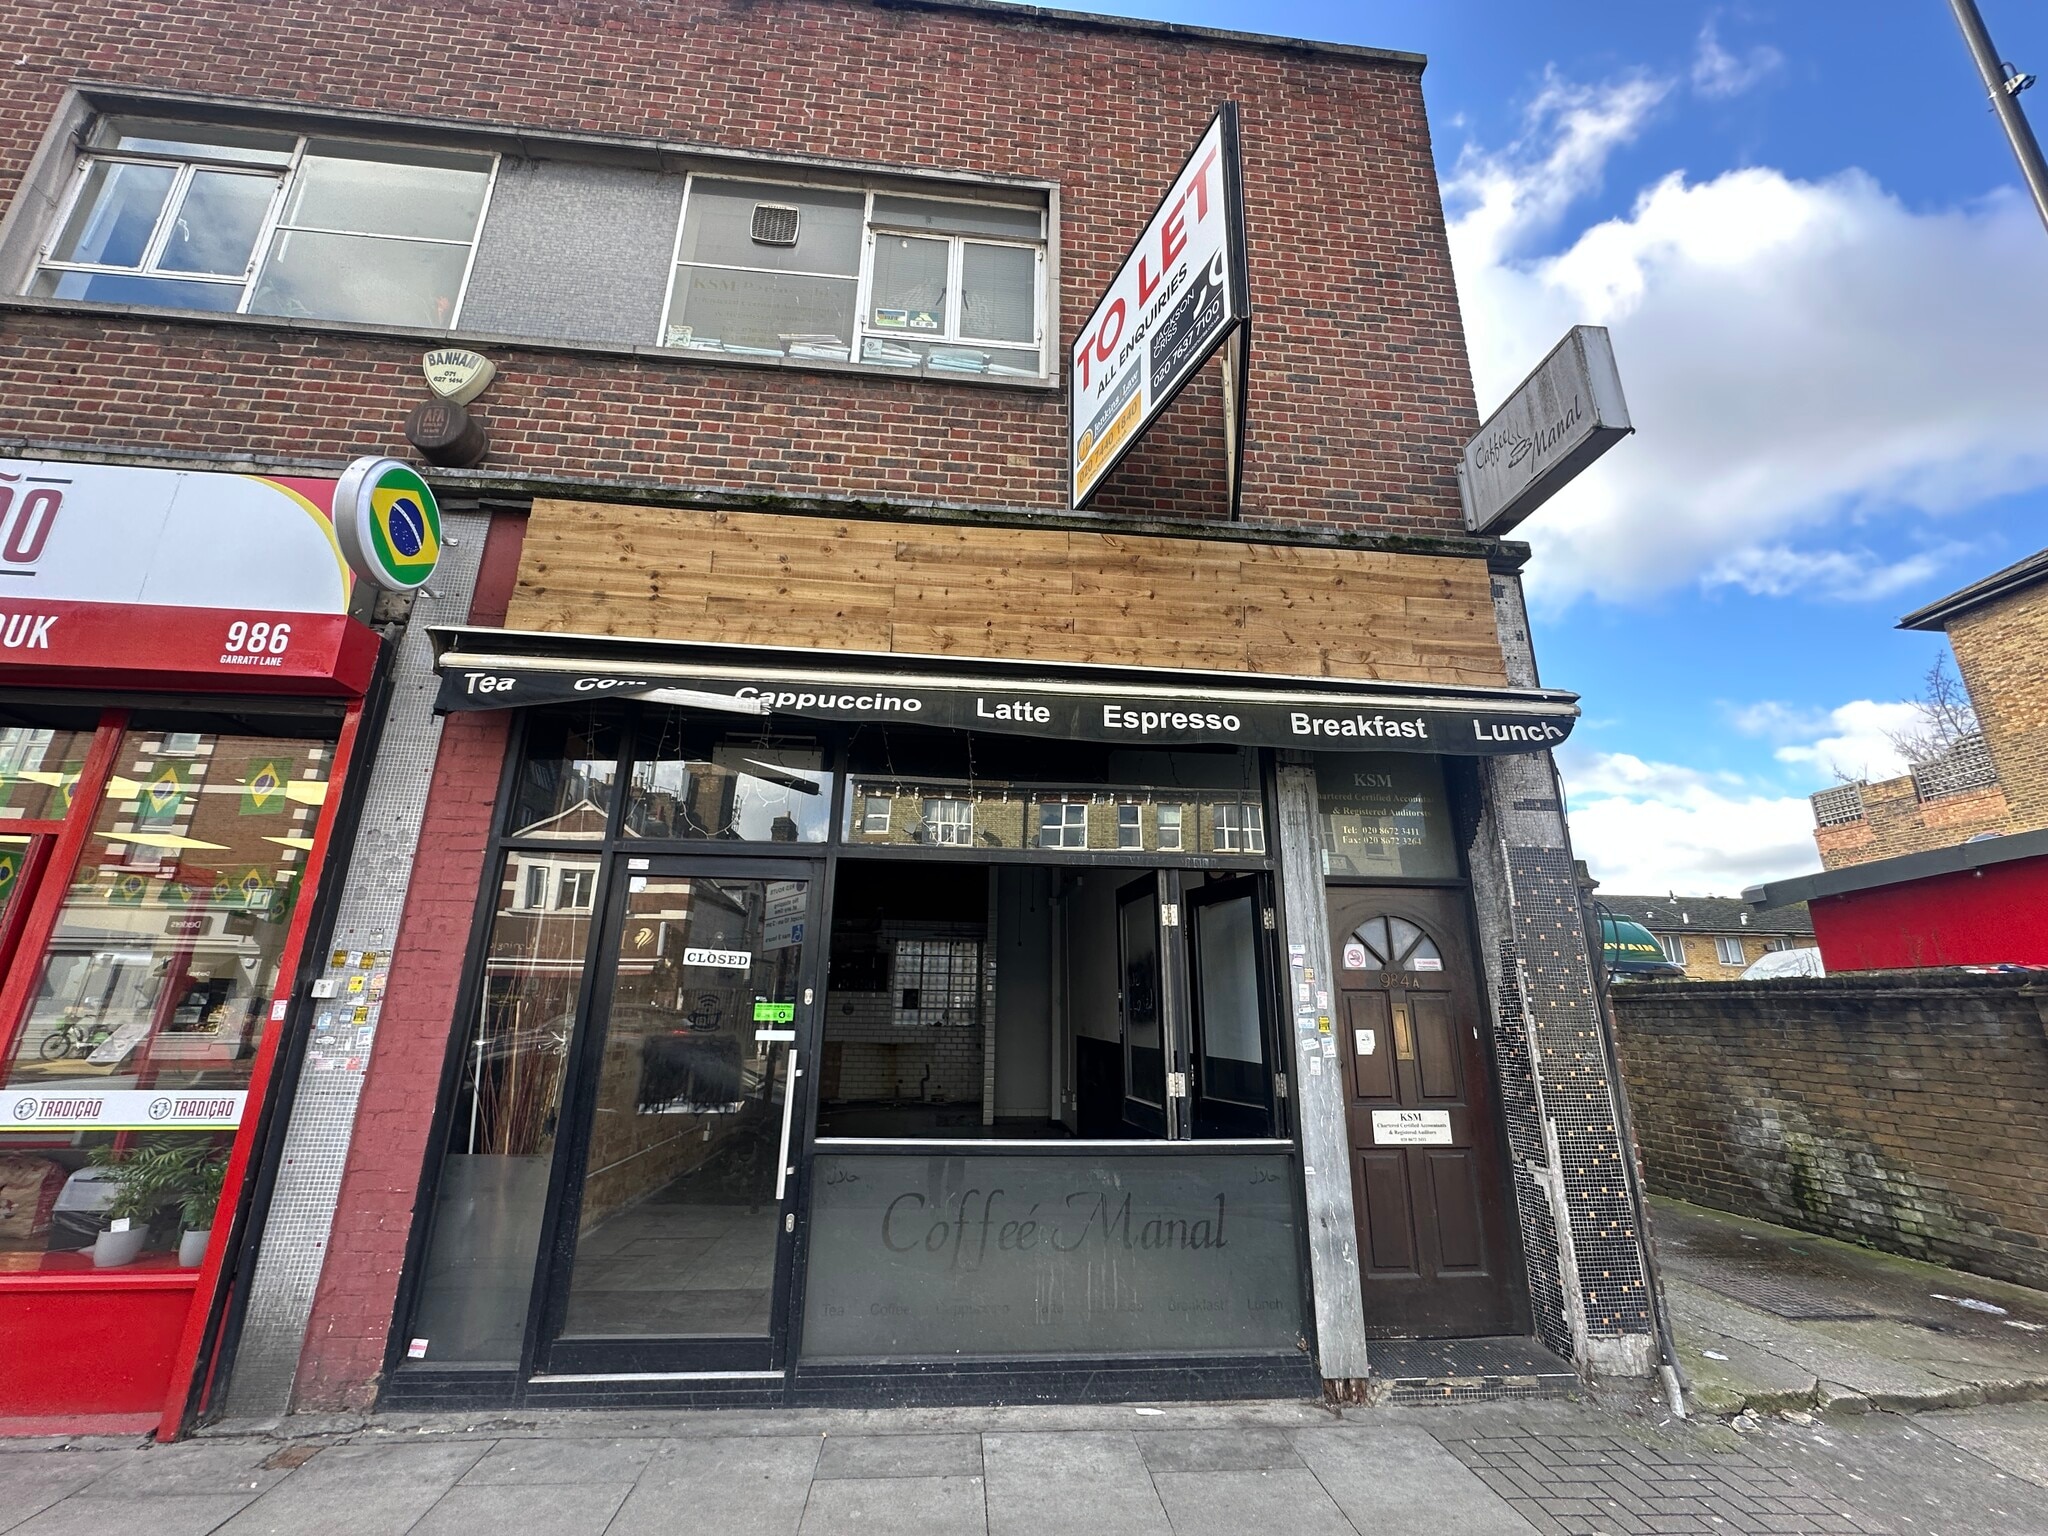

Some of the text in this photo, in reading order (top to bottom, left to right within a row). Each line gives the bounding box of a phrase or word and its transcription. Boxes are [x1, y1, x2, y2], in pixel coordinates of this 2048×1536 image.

[1077, 297, 1126, 391] TO
[1138, 146, 1217, 310] LET
[1097, 365, 1116, 400] ALL
[1119, 262, 1188, 369] ENQUIRIES
[1154, 288, 1195, 350] JACKSON
[1153, 322, 1178, 359] CRISS
[1153, 361, 1171, 387] 020
[1173, 330, 1194, 361] 7637
[1195, 300, 1220, 336] 7100
[1530, 395, 1583, 473] Manal
[1079, 459, 1093, 483] 020
[225, 621, 291, 653] 986
[220, 654, 283, 666] GARRATT LANE
[463, 672, 1564, 742] Tea Cappuccino Latte Espresso Breakfast Lunch
[1353, 773, 1392, 788] KSM
[1343, 807, 1387, 817] Registered
[1362, 826, 1378, 835] 020
[1363, 836, 1379, 845] 020
[687, 952, 748, 965] CLOSED
[1400, 1113, 1422, 1121] KSM
[1052, 1190, 1228, 1254] Manal
